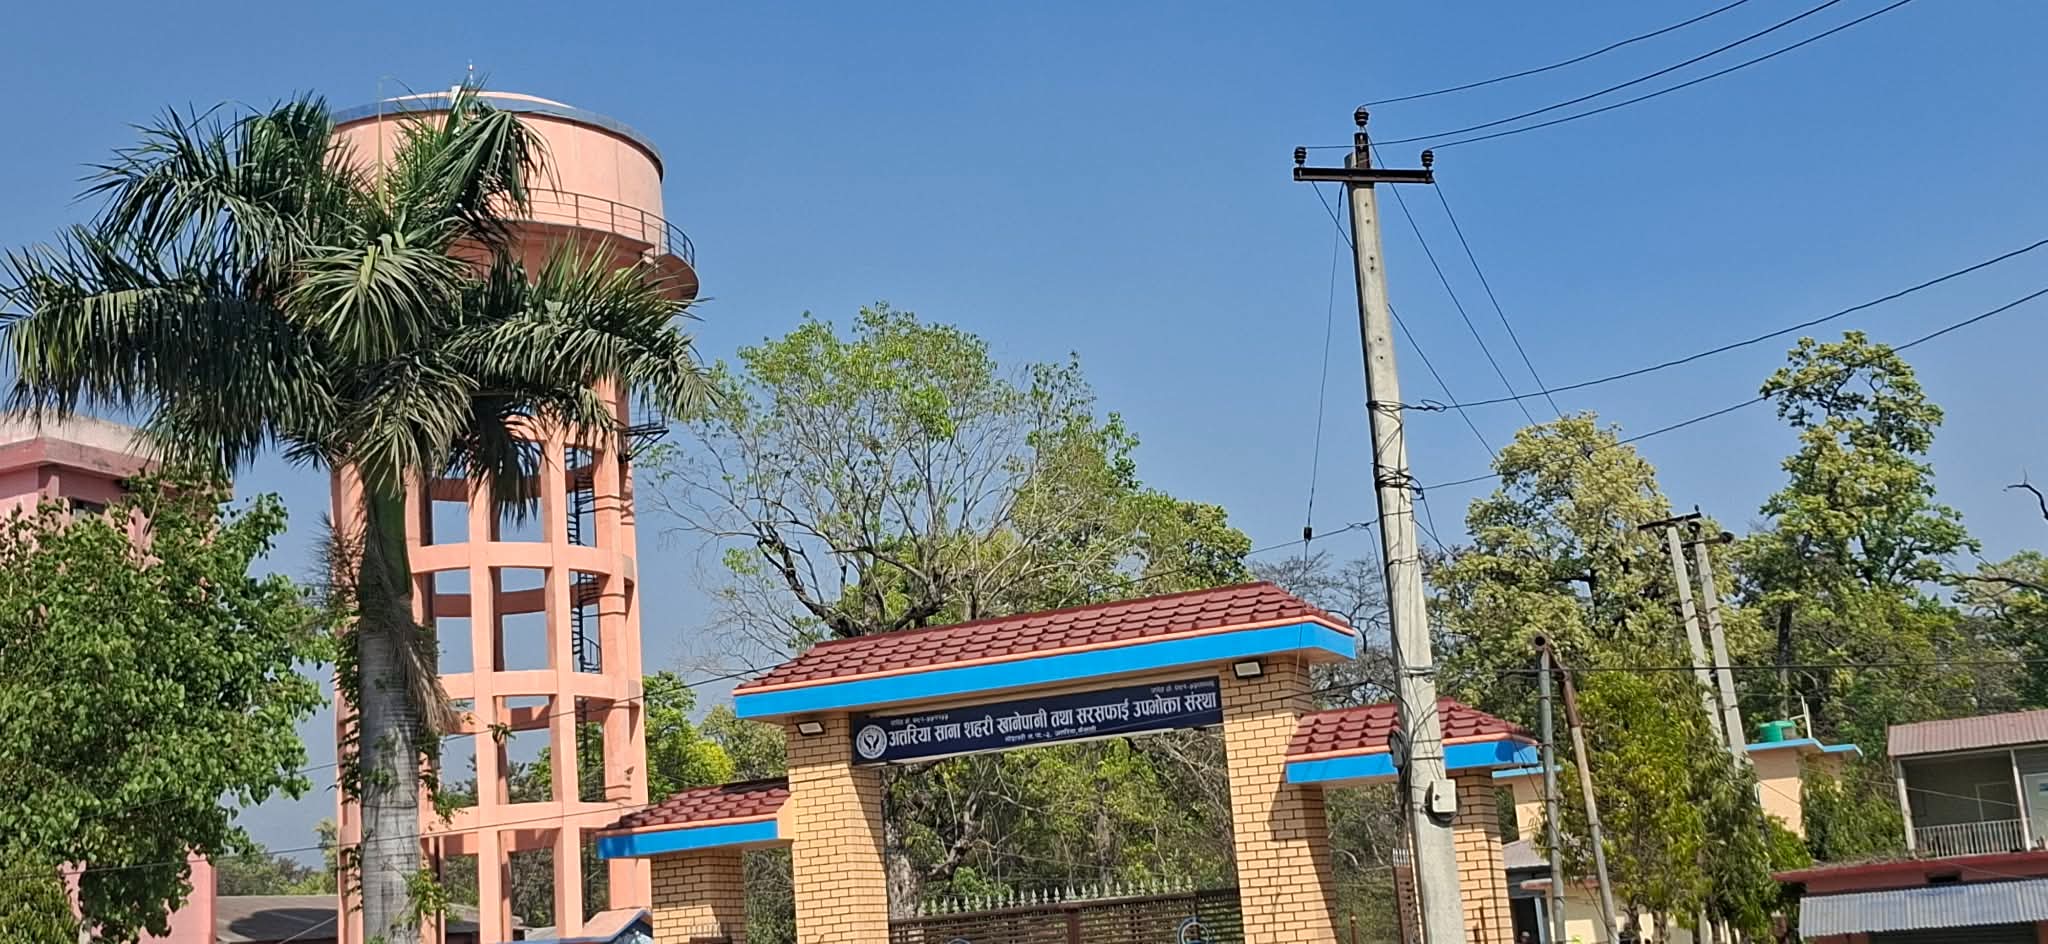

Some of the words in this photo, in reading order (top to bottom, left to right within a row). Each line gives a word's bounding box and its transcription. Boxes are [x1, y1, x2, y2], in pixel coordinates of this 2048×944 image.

[934, 723, 961, 742] साना
[963, 714, 994, 738] शहरी
[996, 708, 1048, 734] खानेपानी
[1050, 708, 1073, 728] तथा
[1076, 698, 1130, 725] सरसफाई
[1132, 694, 1181, 717] उपभोक्ता
[1184, 692, 1217, 712] संस्था
